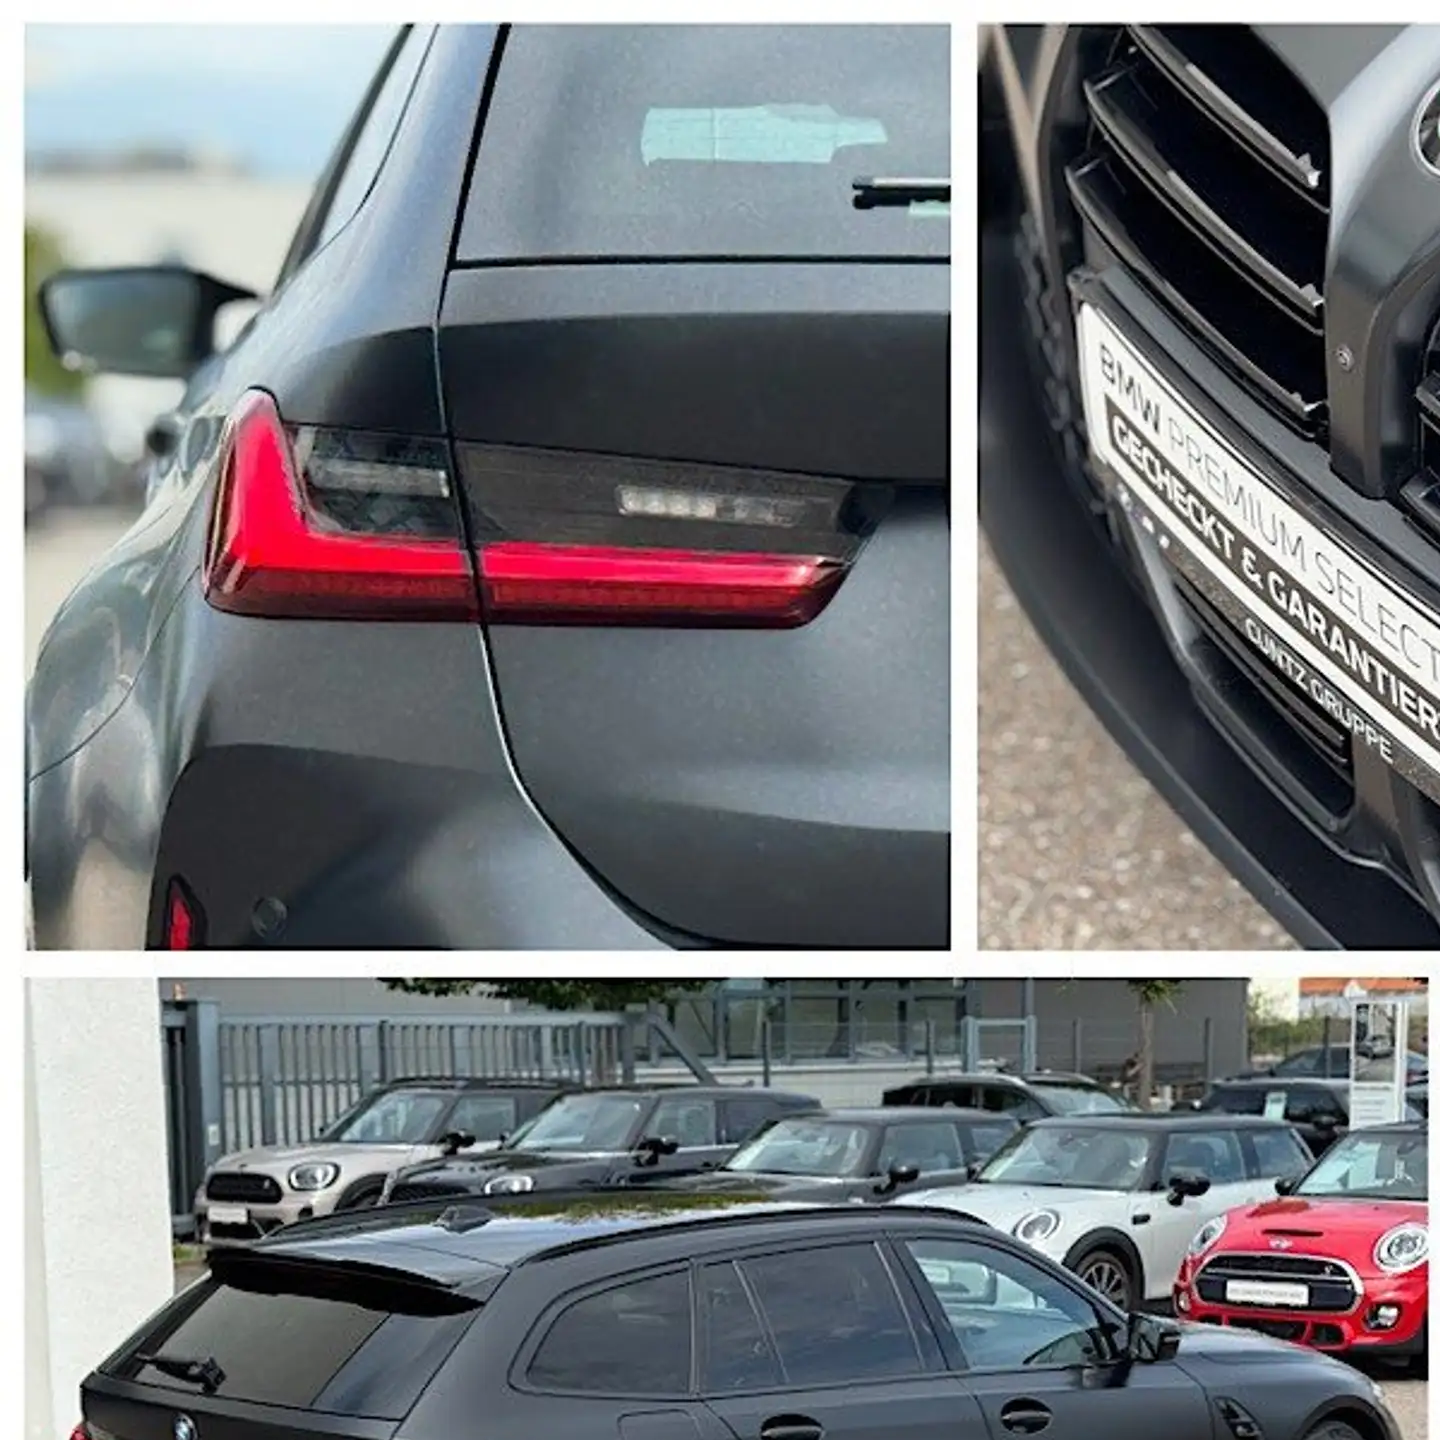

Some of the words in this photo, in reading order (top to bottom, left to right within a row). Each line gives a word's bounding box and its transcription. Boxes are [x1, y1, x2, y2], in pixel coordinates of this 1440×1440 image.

[1100, 345, 1161, 435] BMW
[1168, 416, 1307, 572] PREMIUM
[1112, 414, 1235, 559] GECHECKT
[1240, 547, 1264, 590] &
[1244, 618, 1308, 691] CUNTZ
[1309, 675, 1395, 764] GRUPPE
